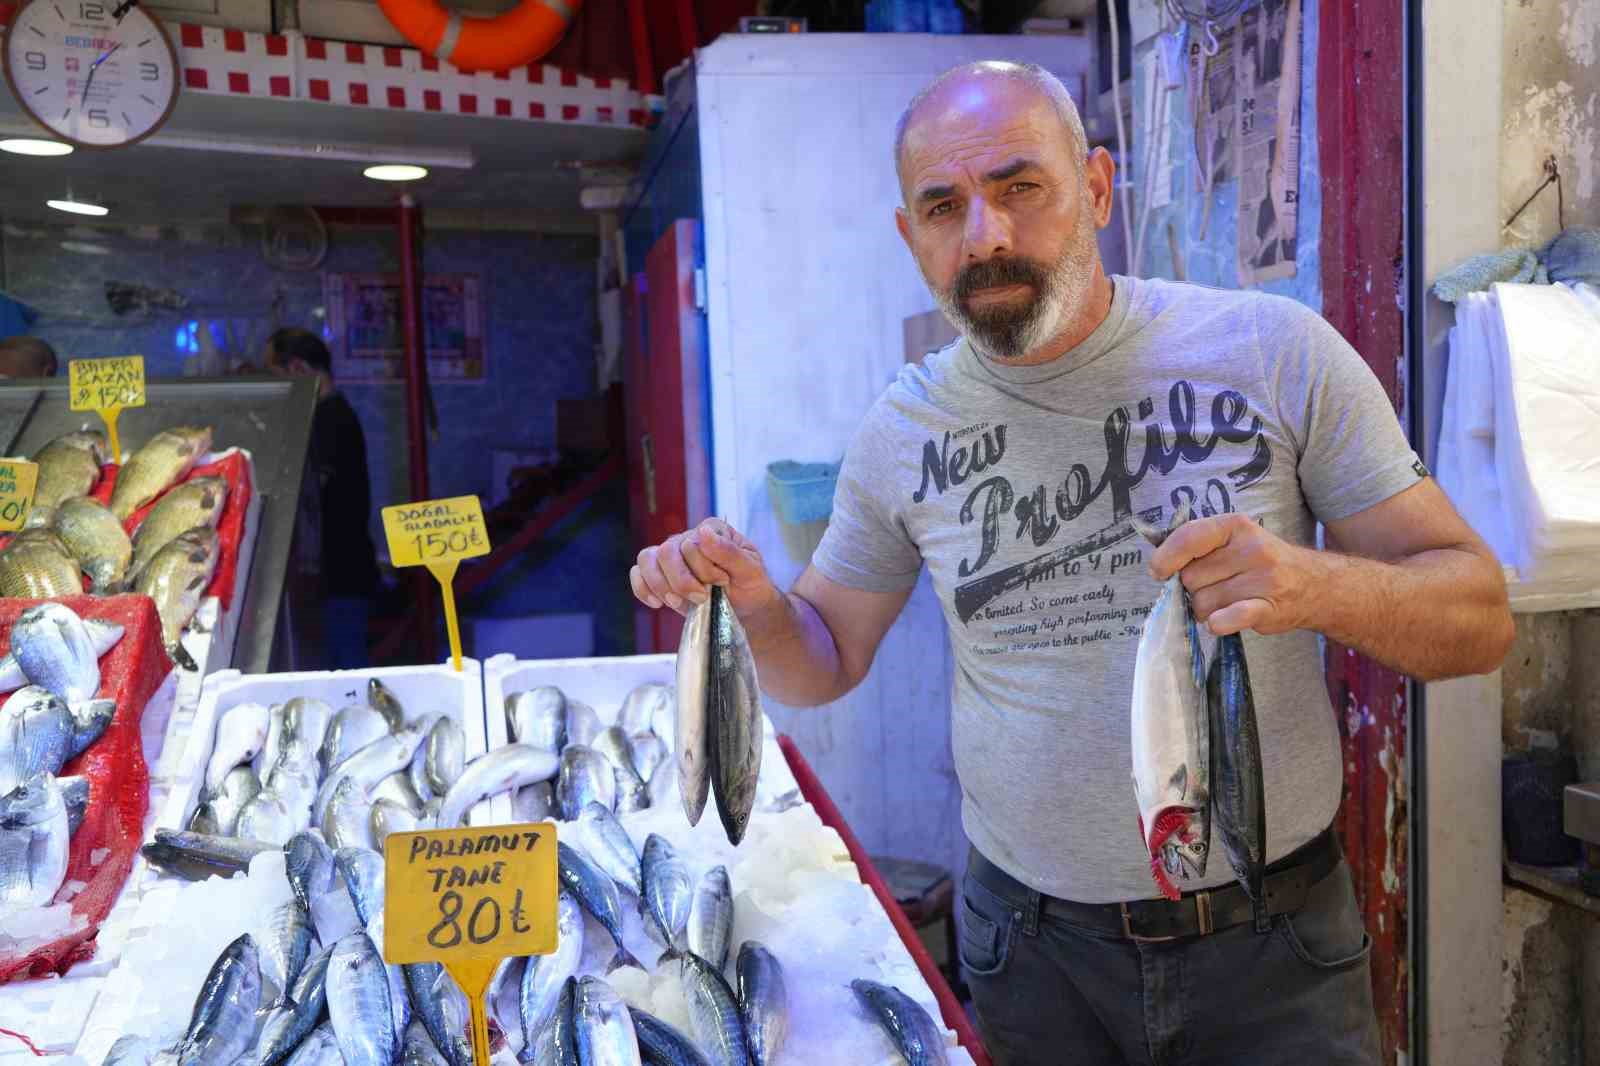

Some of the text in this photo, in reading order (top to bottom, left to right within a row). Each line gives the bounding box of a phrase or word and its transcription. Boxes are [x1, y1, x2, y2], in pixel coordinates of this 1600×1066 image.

[80, 3, 104, 20] 12
[25, 51, 47, 70] 9
[139, 62, 159, 81] 3
[88, 109, 110, 128] 6
[913, 424, 1007, 504] New
[958, 379, 1262, 578] Profile
[1063, 561, 1081, 576] to
[1110, 549, 1142, 575] pm
[1030, 596, 1045, 611] So
[1049, 594, 1079, 607] come
[1083, 584, 1115, 604] early
[1040, 615, 1064, 632] high
[1067, 607, 1128, 628] performing
[1052, 636, 1063, 648] to
[1064, 633, 1079, 646] the
[409, 832, 541, 863] PALAMUT
[427, 861, 507, 892] TANE
